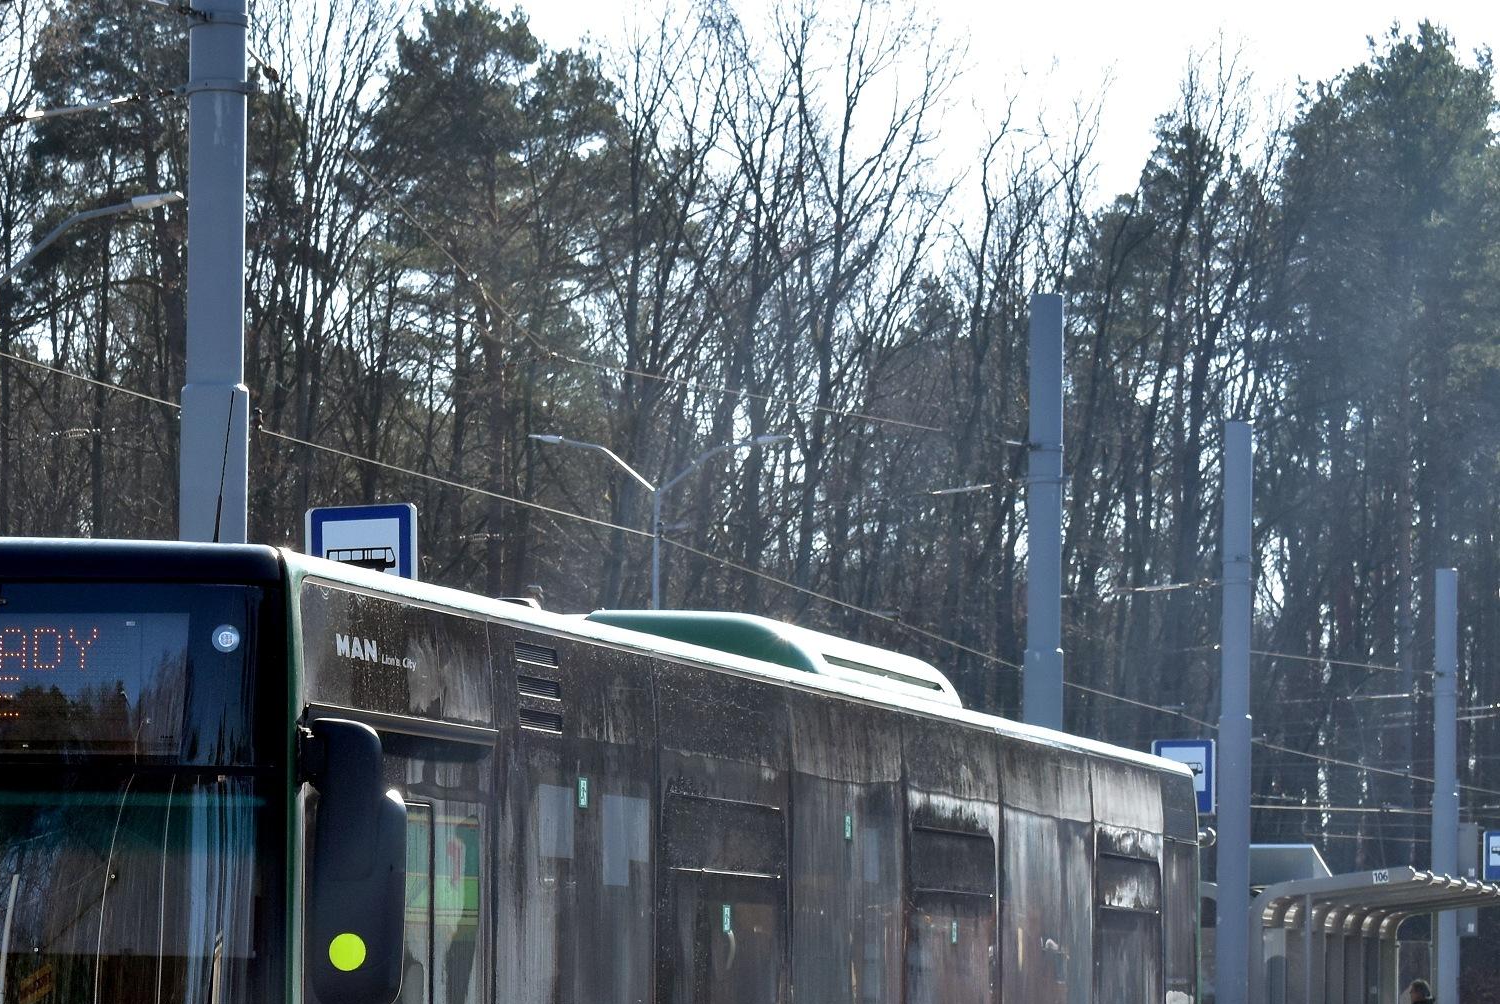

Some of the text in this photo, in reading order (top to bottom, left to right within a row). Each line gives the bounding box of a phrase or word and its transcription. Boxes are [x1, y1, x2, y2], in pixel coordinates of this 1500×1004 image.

[335, 632, 378, 662] MAN
[381, 653, 417, 672] Lion's City
[1374, 871, 1388, 882] 106
